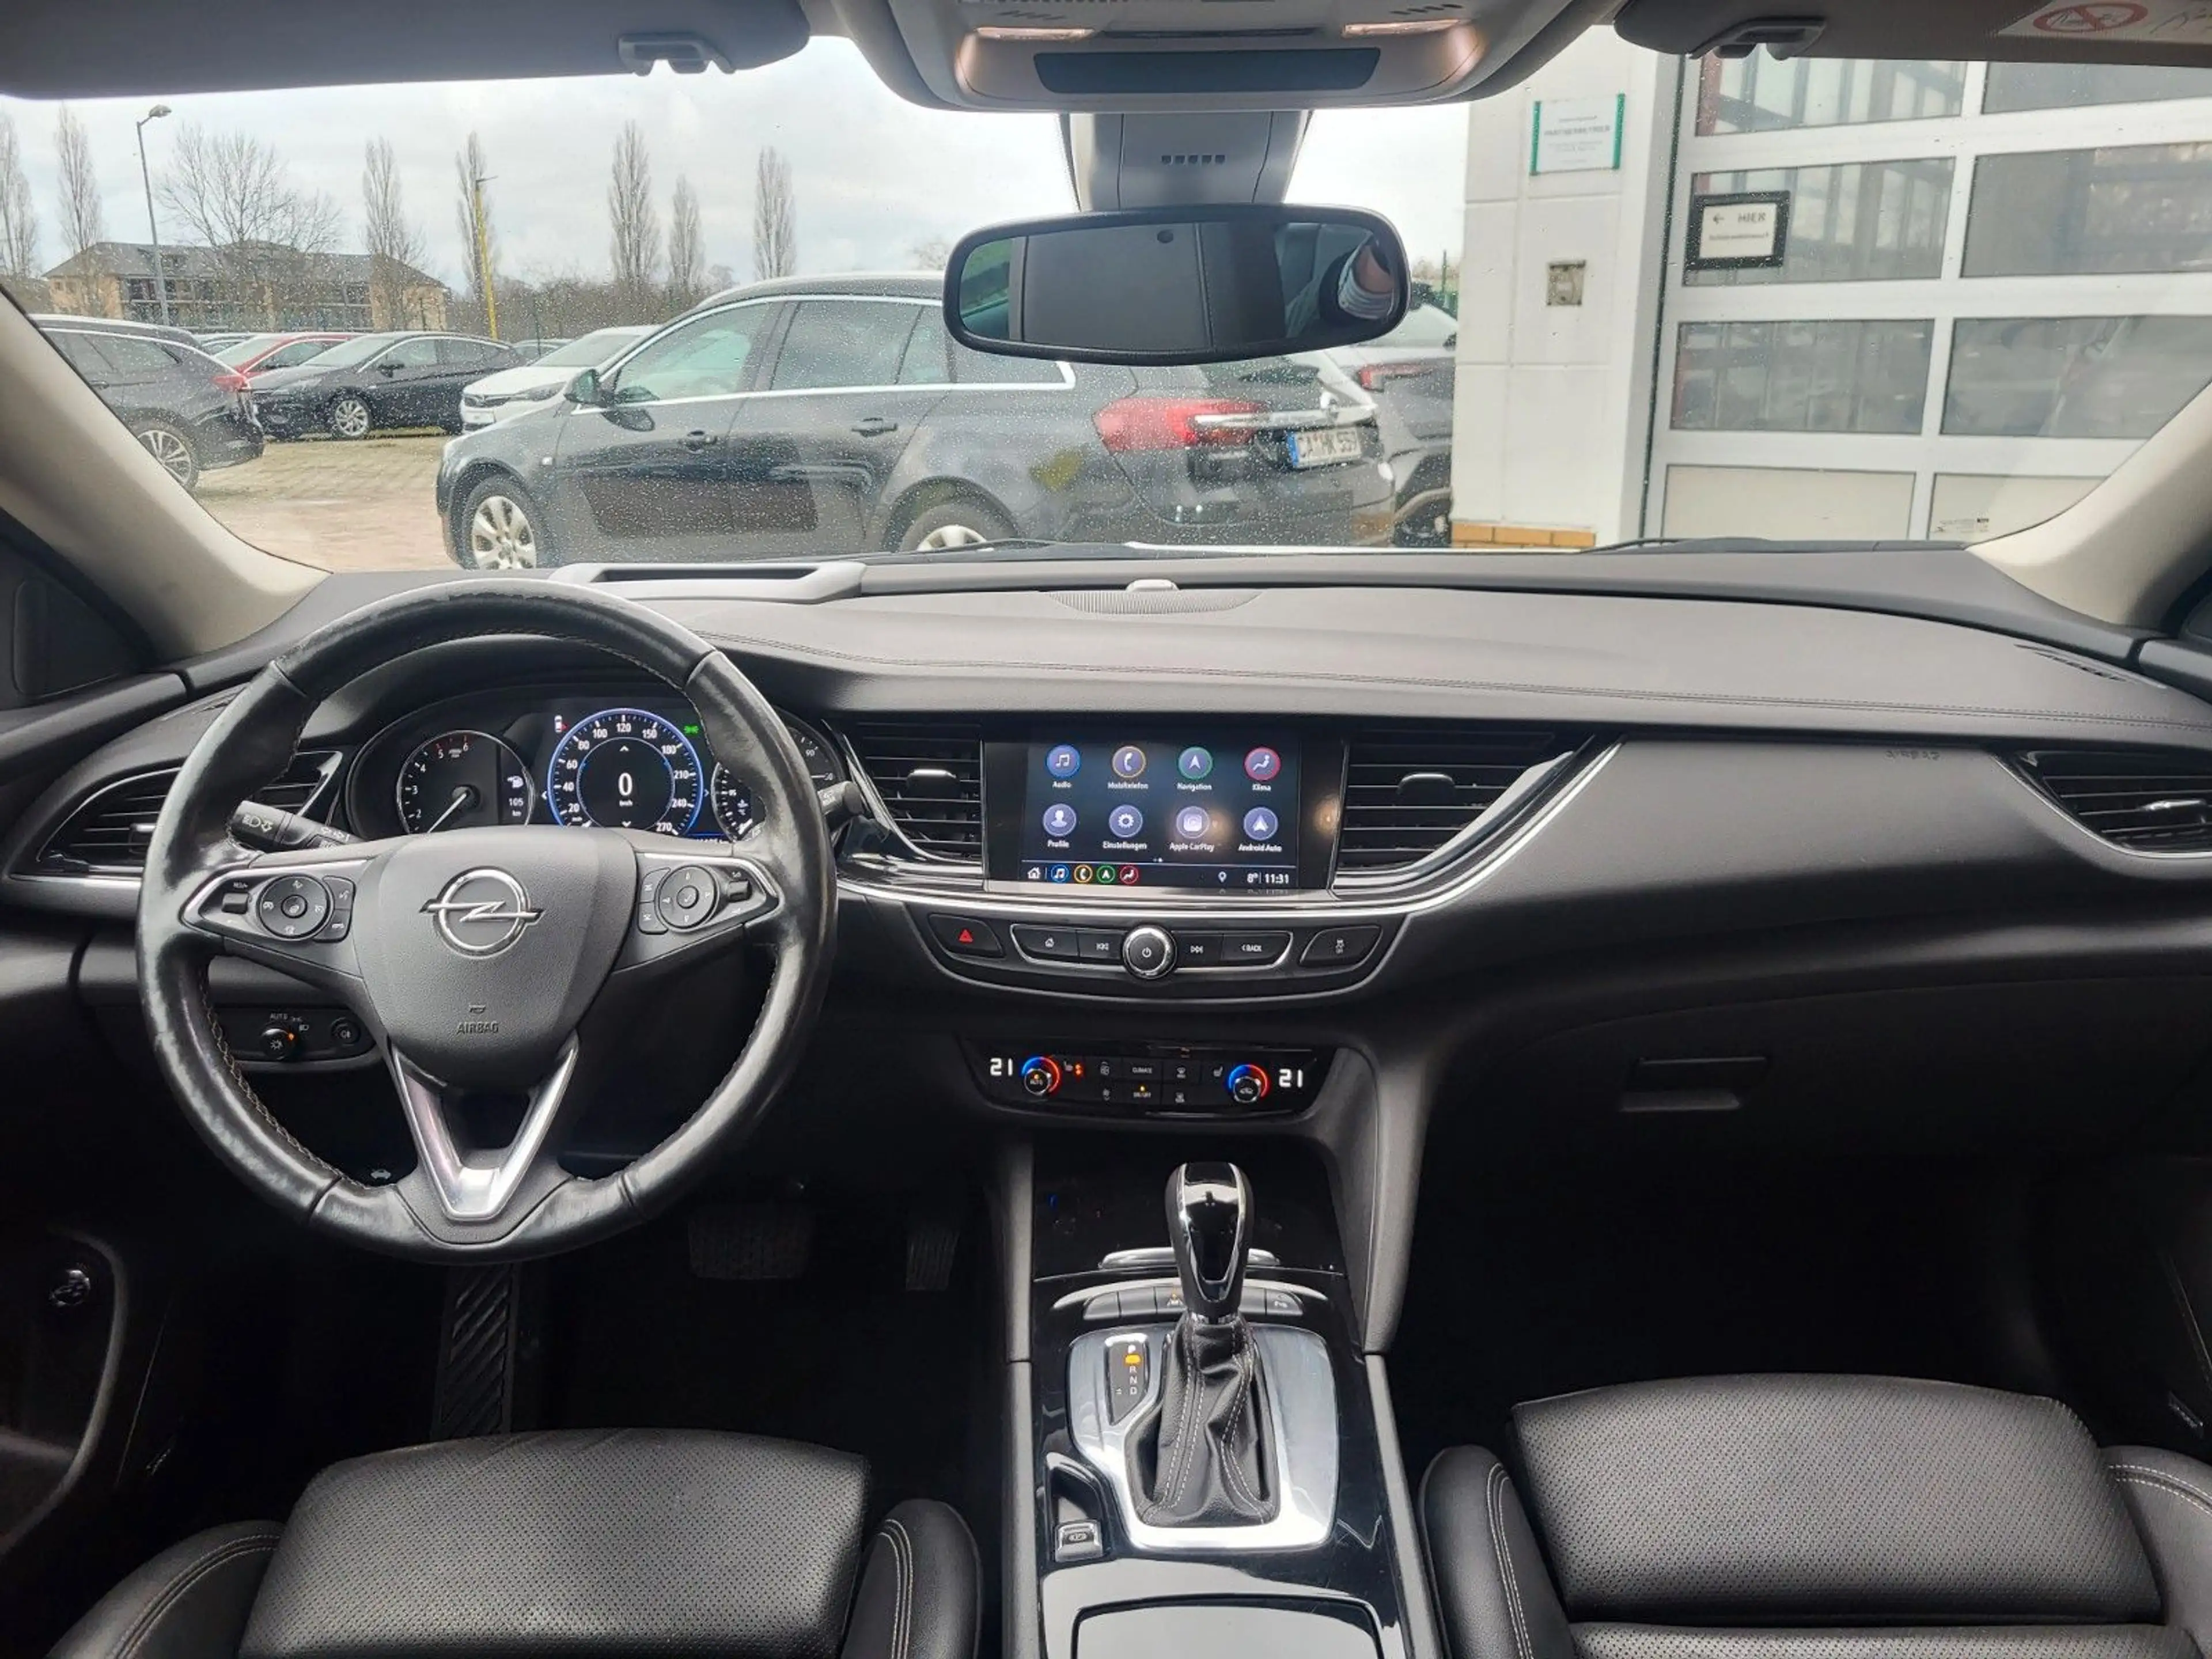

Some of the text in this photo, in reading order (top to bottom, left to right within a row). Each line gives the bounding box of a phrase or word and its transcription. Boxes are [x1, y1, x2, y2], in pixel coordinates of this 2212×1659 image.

[1737, 211, 1766, 224] HIER
[616, 723, 631, 732] 120
[592, 728, 608, 738] 100
[642, 729, 657, 738] 150
[463, 743, 469, 751] 6
[578, 740, 590, 750] 80
[661, 745, 676, 755] 180
[438, 749, 444, 759] 5
[420, 764, 426, 772] 4
[566, 760, 577, 770] 60
[674, 770, 689, 779] 210
[562, 782, 574, 791] 40
[618, 772, 632, 796] 0
[1177, 783, 1212, 792] Navigation
[1252, 783, 1271, 791] Klima
[411, 785, 418, 795] 3
[509, 797, 524, 806] 105
[672, 798, 687, 808] 240
[567, 802, 580, 813] 20
[415, 809, 422, 818] 2
[656, 822, 672, 832] 270
[1047, 839, 1070, 848] Profile
[1102, 840, 1147, 851] Einstellungen
[1169, 842, 1214, 853] Apple CarPlay
[1238, 843, 1282, 853] Android Auto
[1264, 873, 1289, 884] 11:31
[456, 1020, 499, 1035] AIRBAG
[990, 1058, 1013, 1077] 21
[1278, 1068, 1304, 1088] 21
[1128, 1344, 1137, 1354] P
[1129, 1376, 1138, 1384] N
[1130, 1387, 1138, 1395] D
